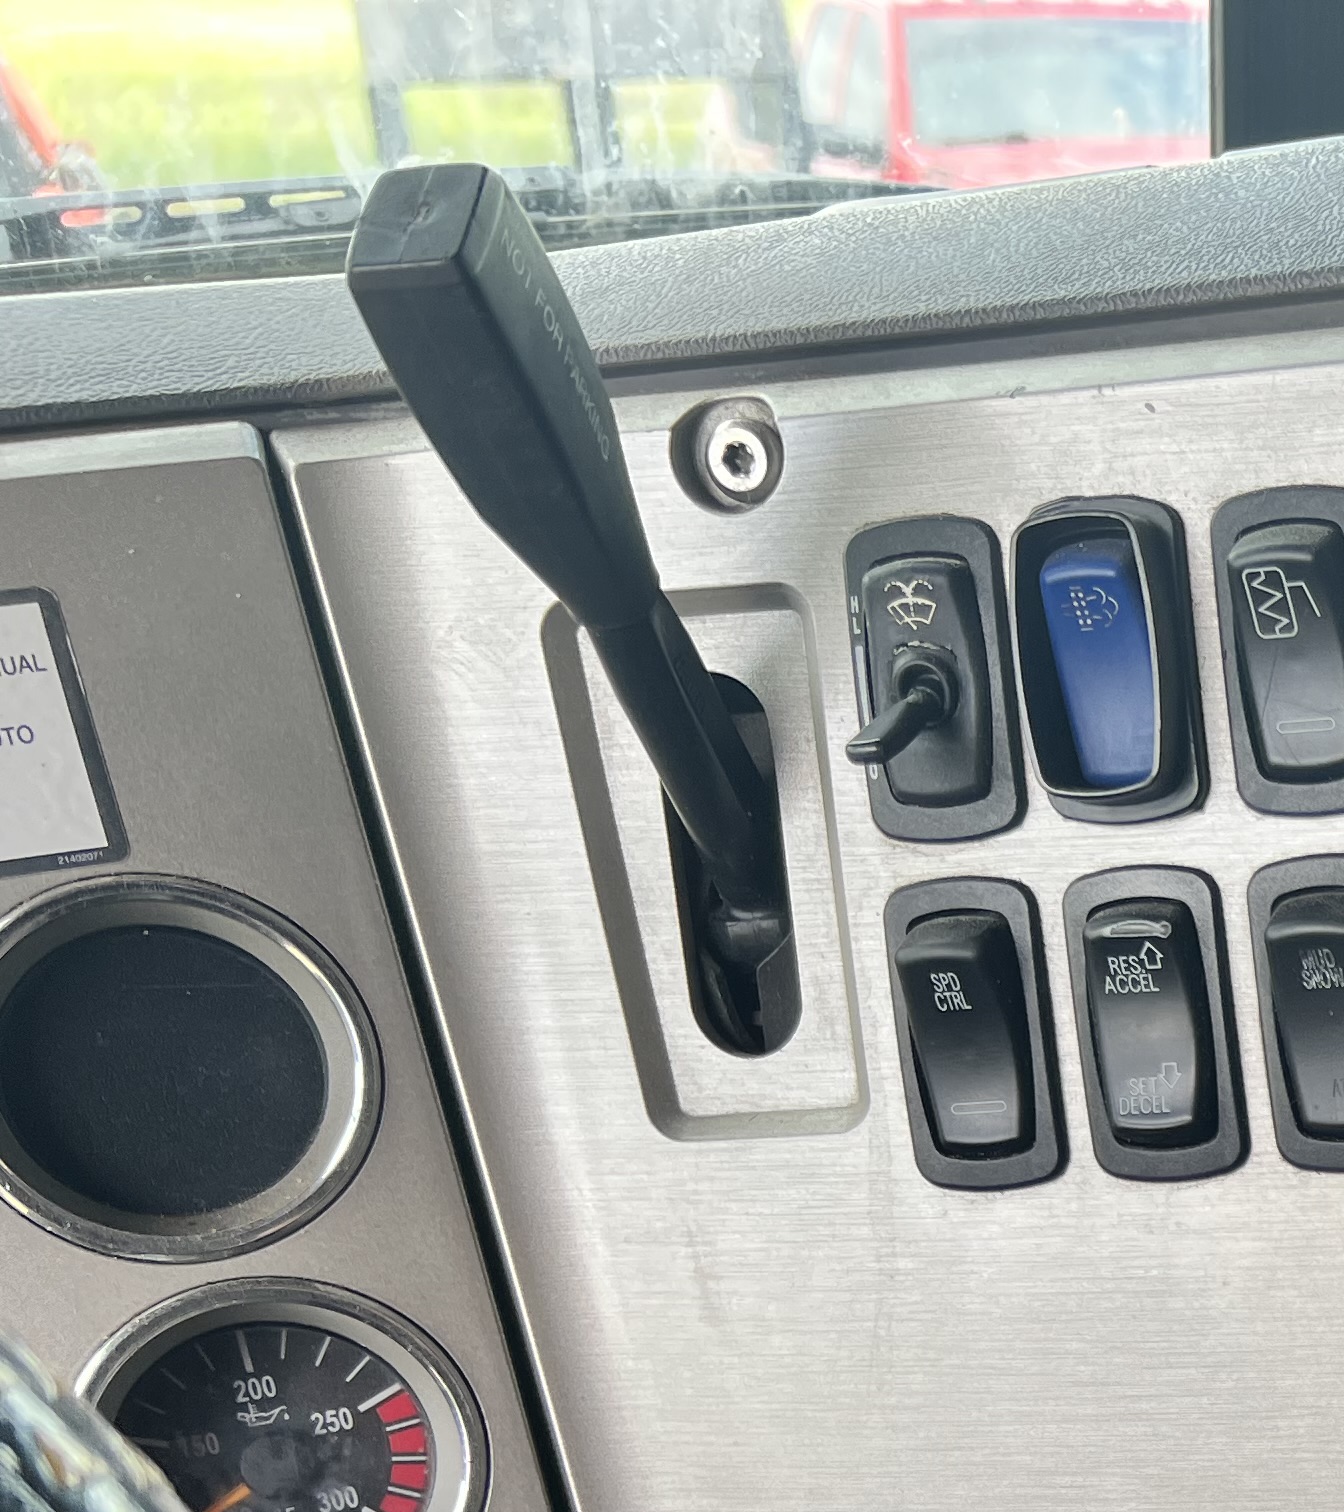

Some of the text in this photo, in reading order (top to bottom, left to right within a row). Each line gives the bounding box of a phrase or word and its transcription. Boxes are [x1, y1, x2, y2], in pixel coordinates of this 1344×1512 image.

[1299, 948, 1336, 970] MUD
[930, 972, 962, 993] SPD
[1104, 973, 1161, 995] ACCEL
[1301, 967, 1344, 990] SNOW
[933, 990, 973, 1013] CTRL
[1129, 1077, 1160, 1095] SET
[1119, 1094, 1172, 1116] DECEL
[233, 1375, 278, 1403] 200
[310, 1406, 355, 1435] 250
[177, 1432, 221, 1458] 150
